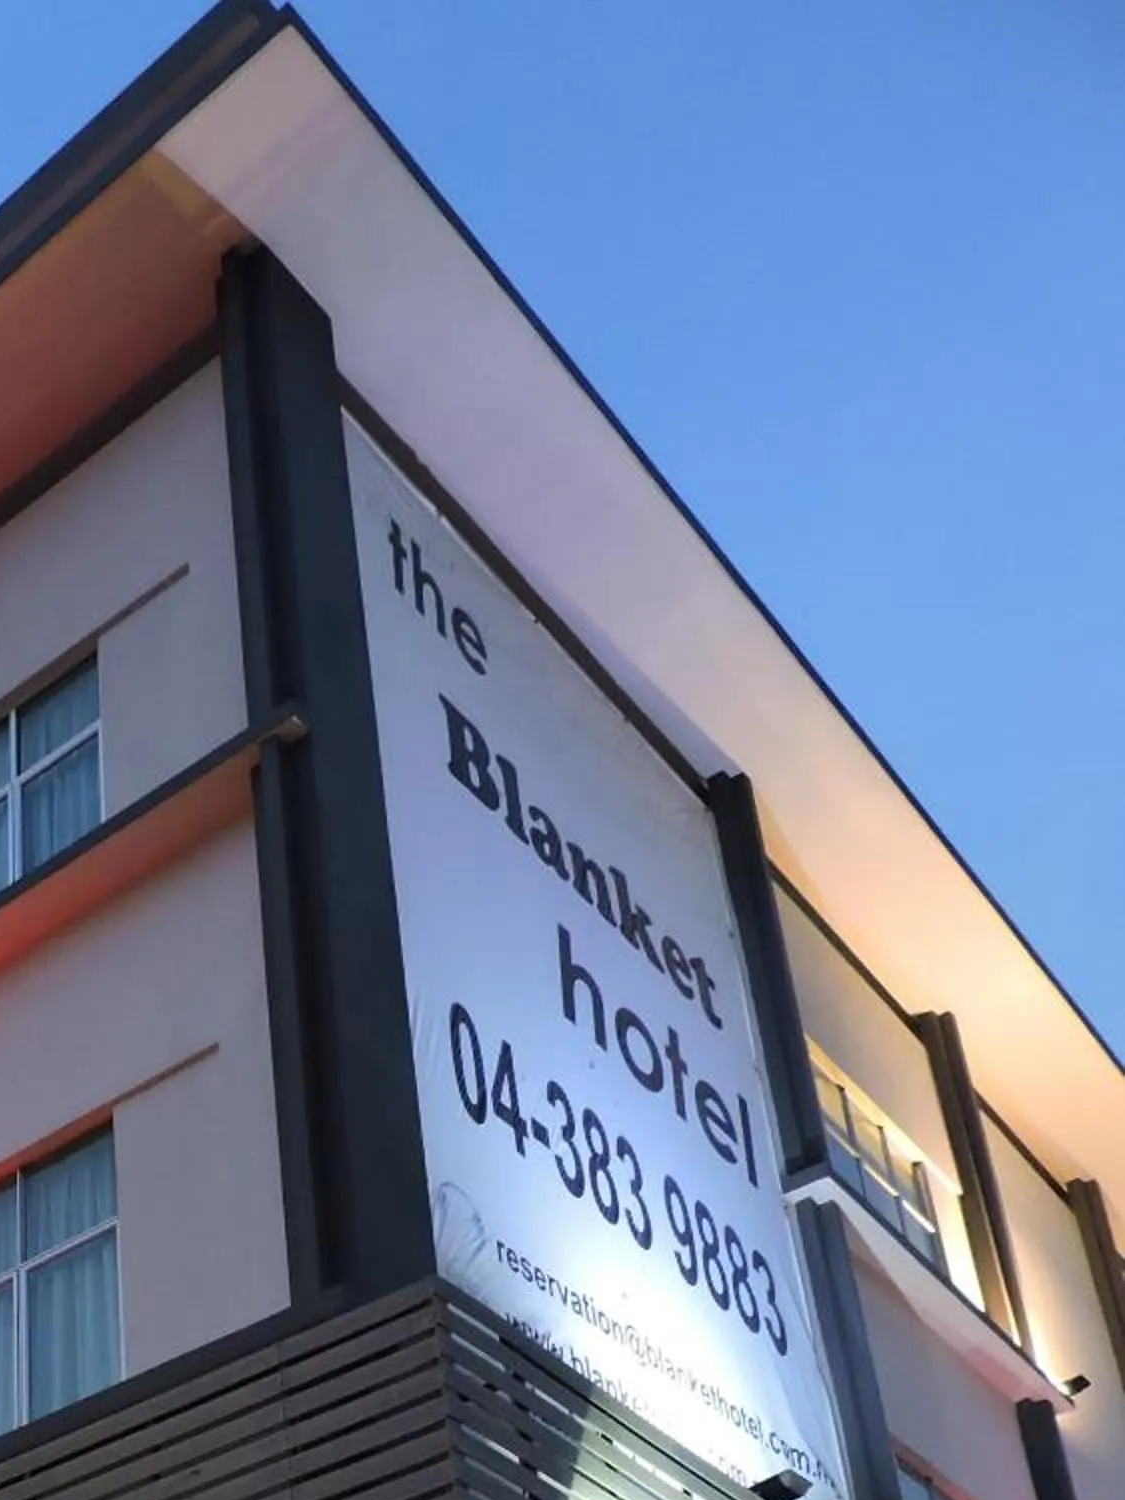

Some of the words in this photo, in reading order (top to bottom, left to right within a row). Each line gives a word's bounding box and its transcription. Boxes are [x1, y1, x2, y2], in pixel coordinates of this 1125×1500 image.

[388, 517, 488, 676] the
[439, 693, 724, 1030] Blanket
[450, 1002, 652, 1252] 04-383
[663, 1174, 788, 1357] 9883
[557, 922, 759, 1188] hotel
